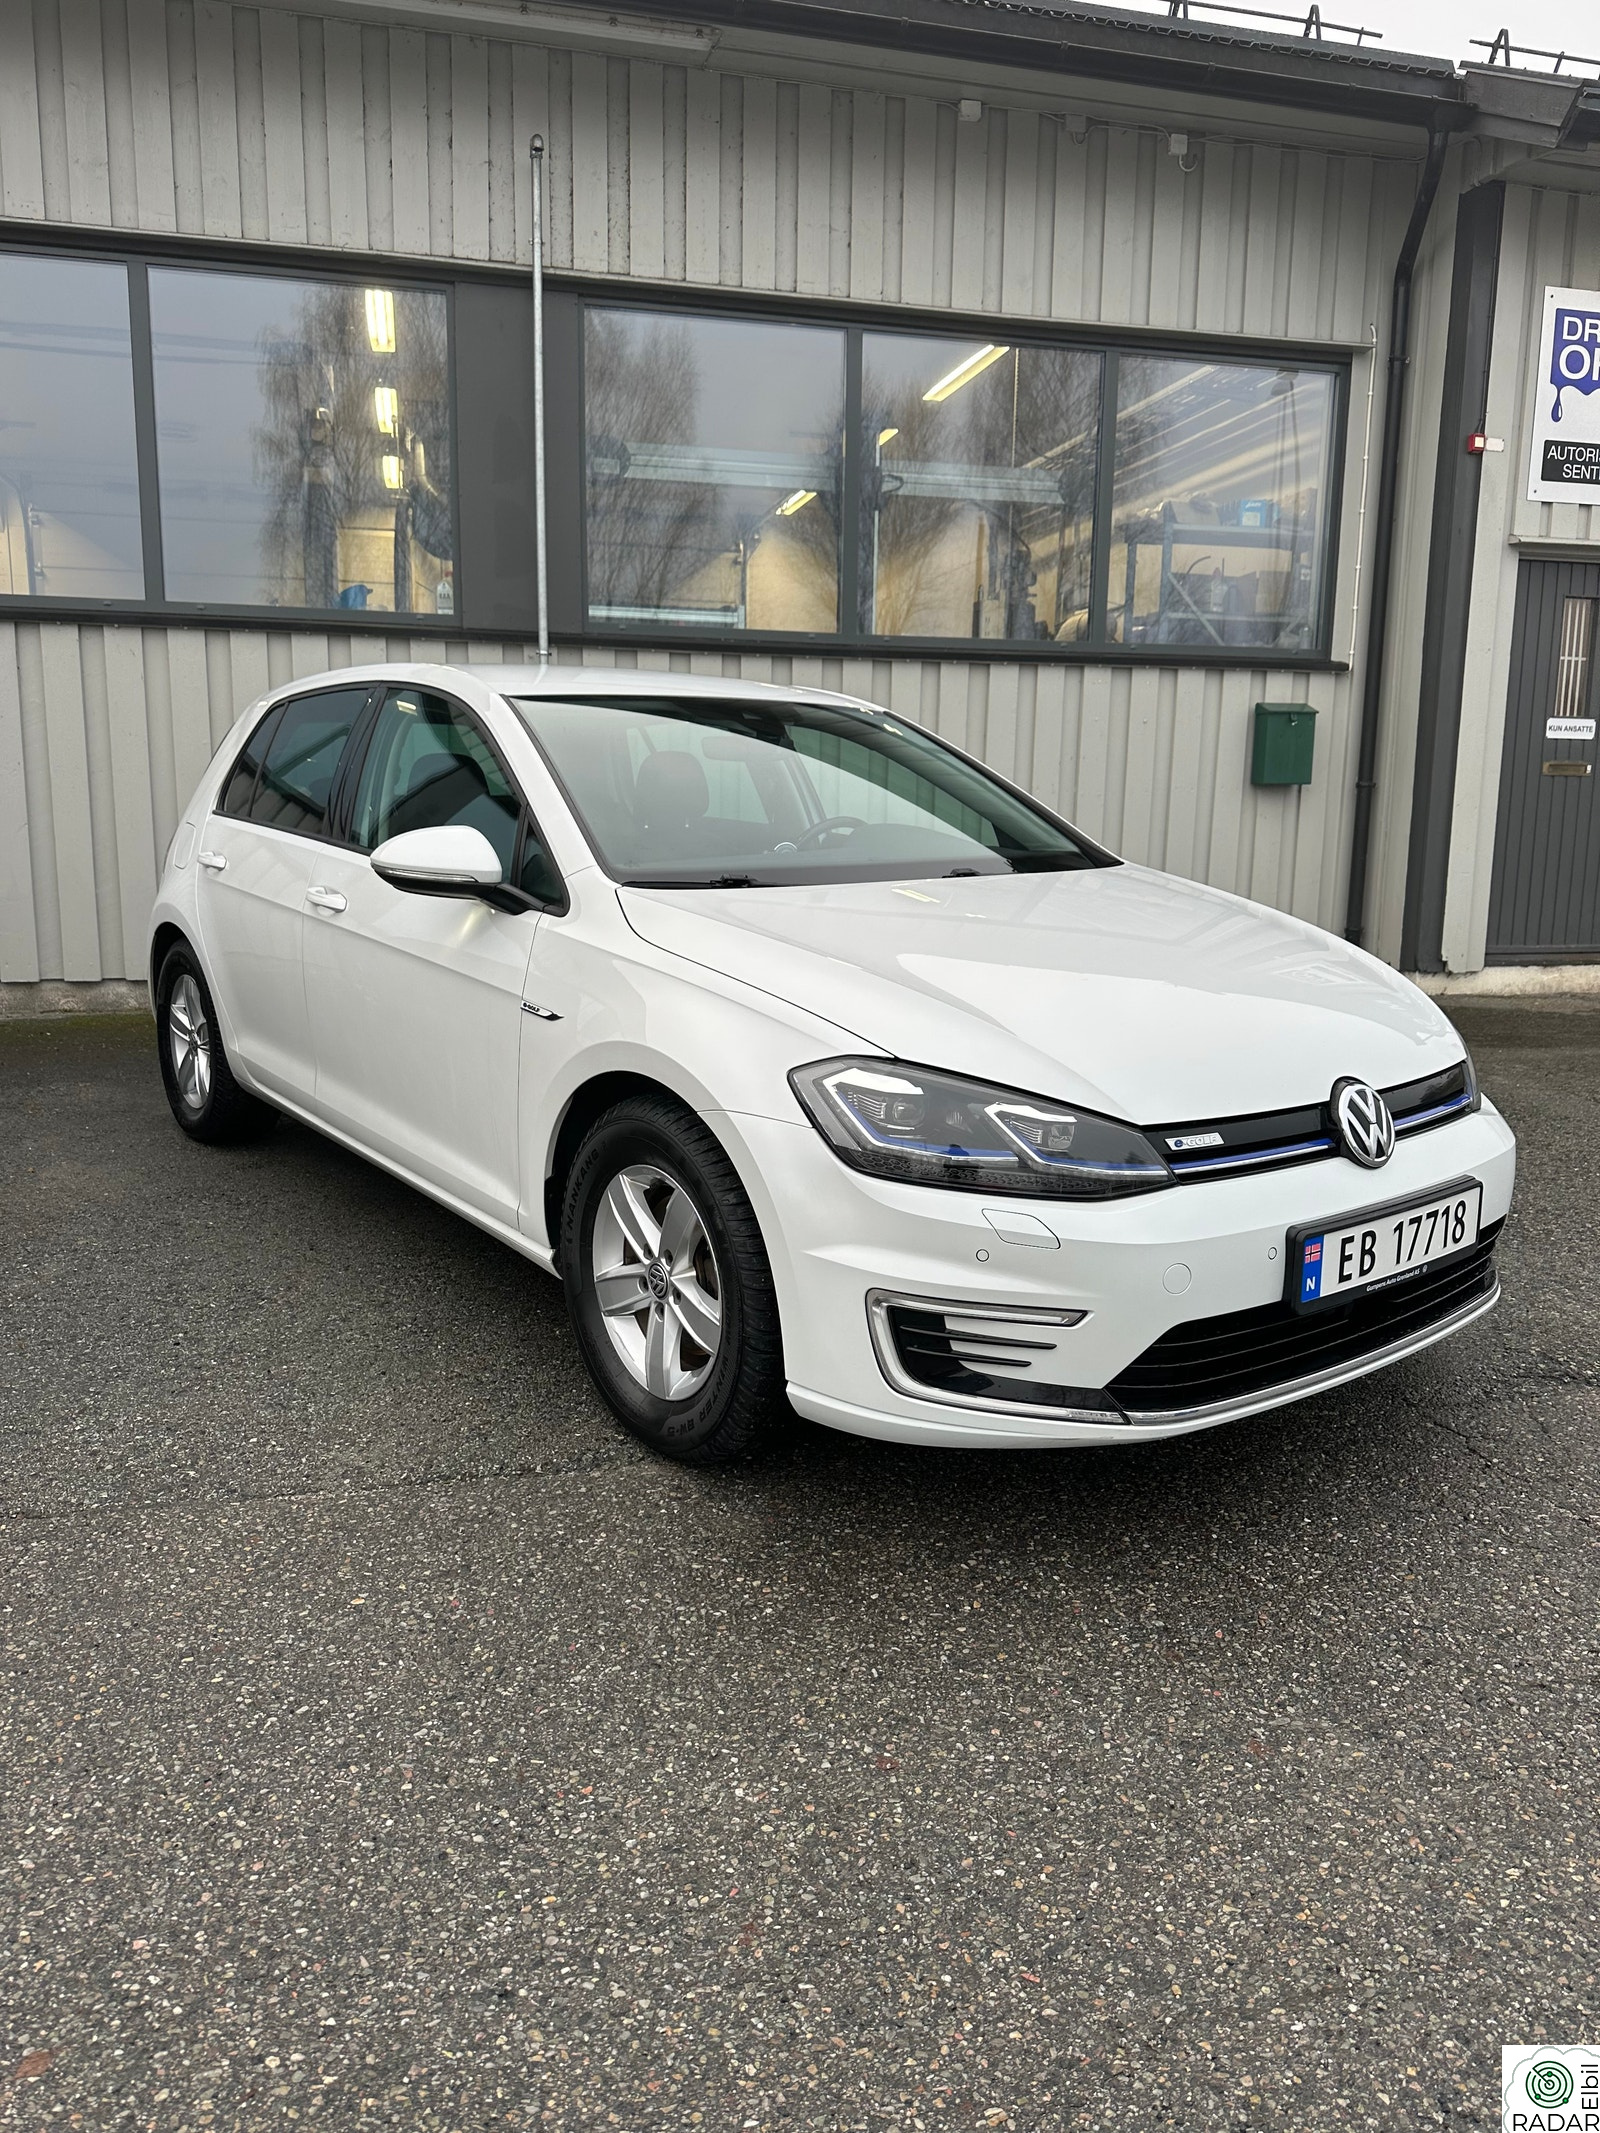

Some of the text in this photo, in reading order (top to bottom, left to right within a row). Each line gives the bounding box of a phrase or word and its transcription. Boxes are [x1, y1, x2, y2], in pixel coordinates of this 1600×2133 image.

[1547, 445, 1600, 463] AUTORI
[1562, 463, 1600, 480] SENT
[567, 1149, 599, 1230] NANKANG
[1338, 1200, 1466, 1284] EB 17718
[1306, 1276, 1315, 1291] N
